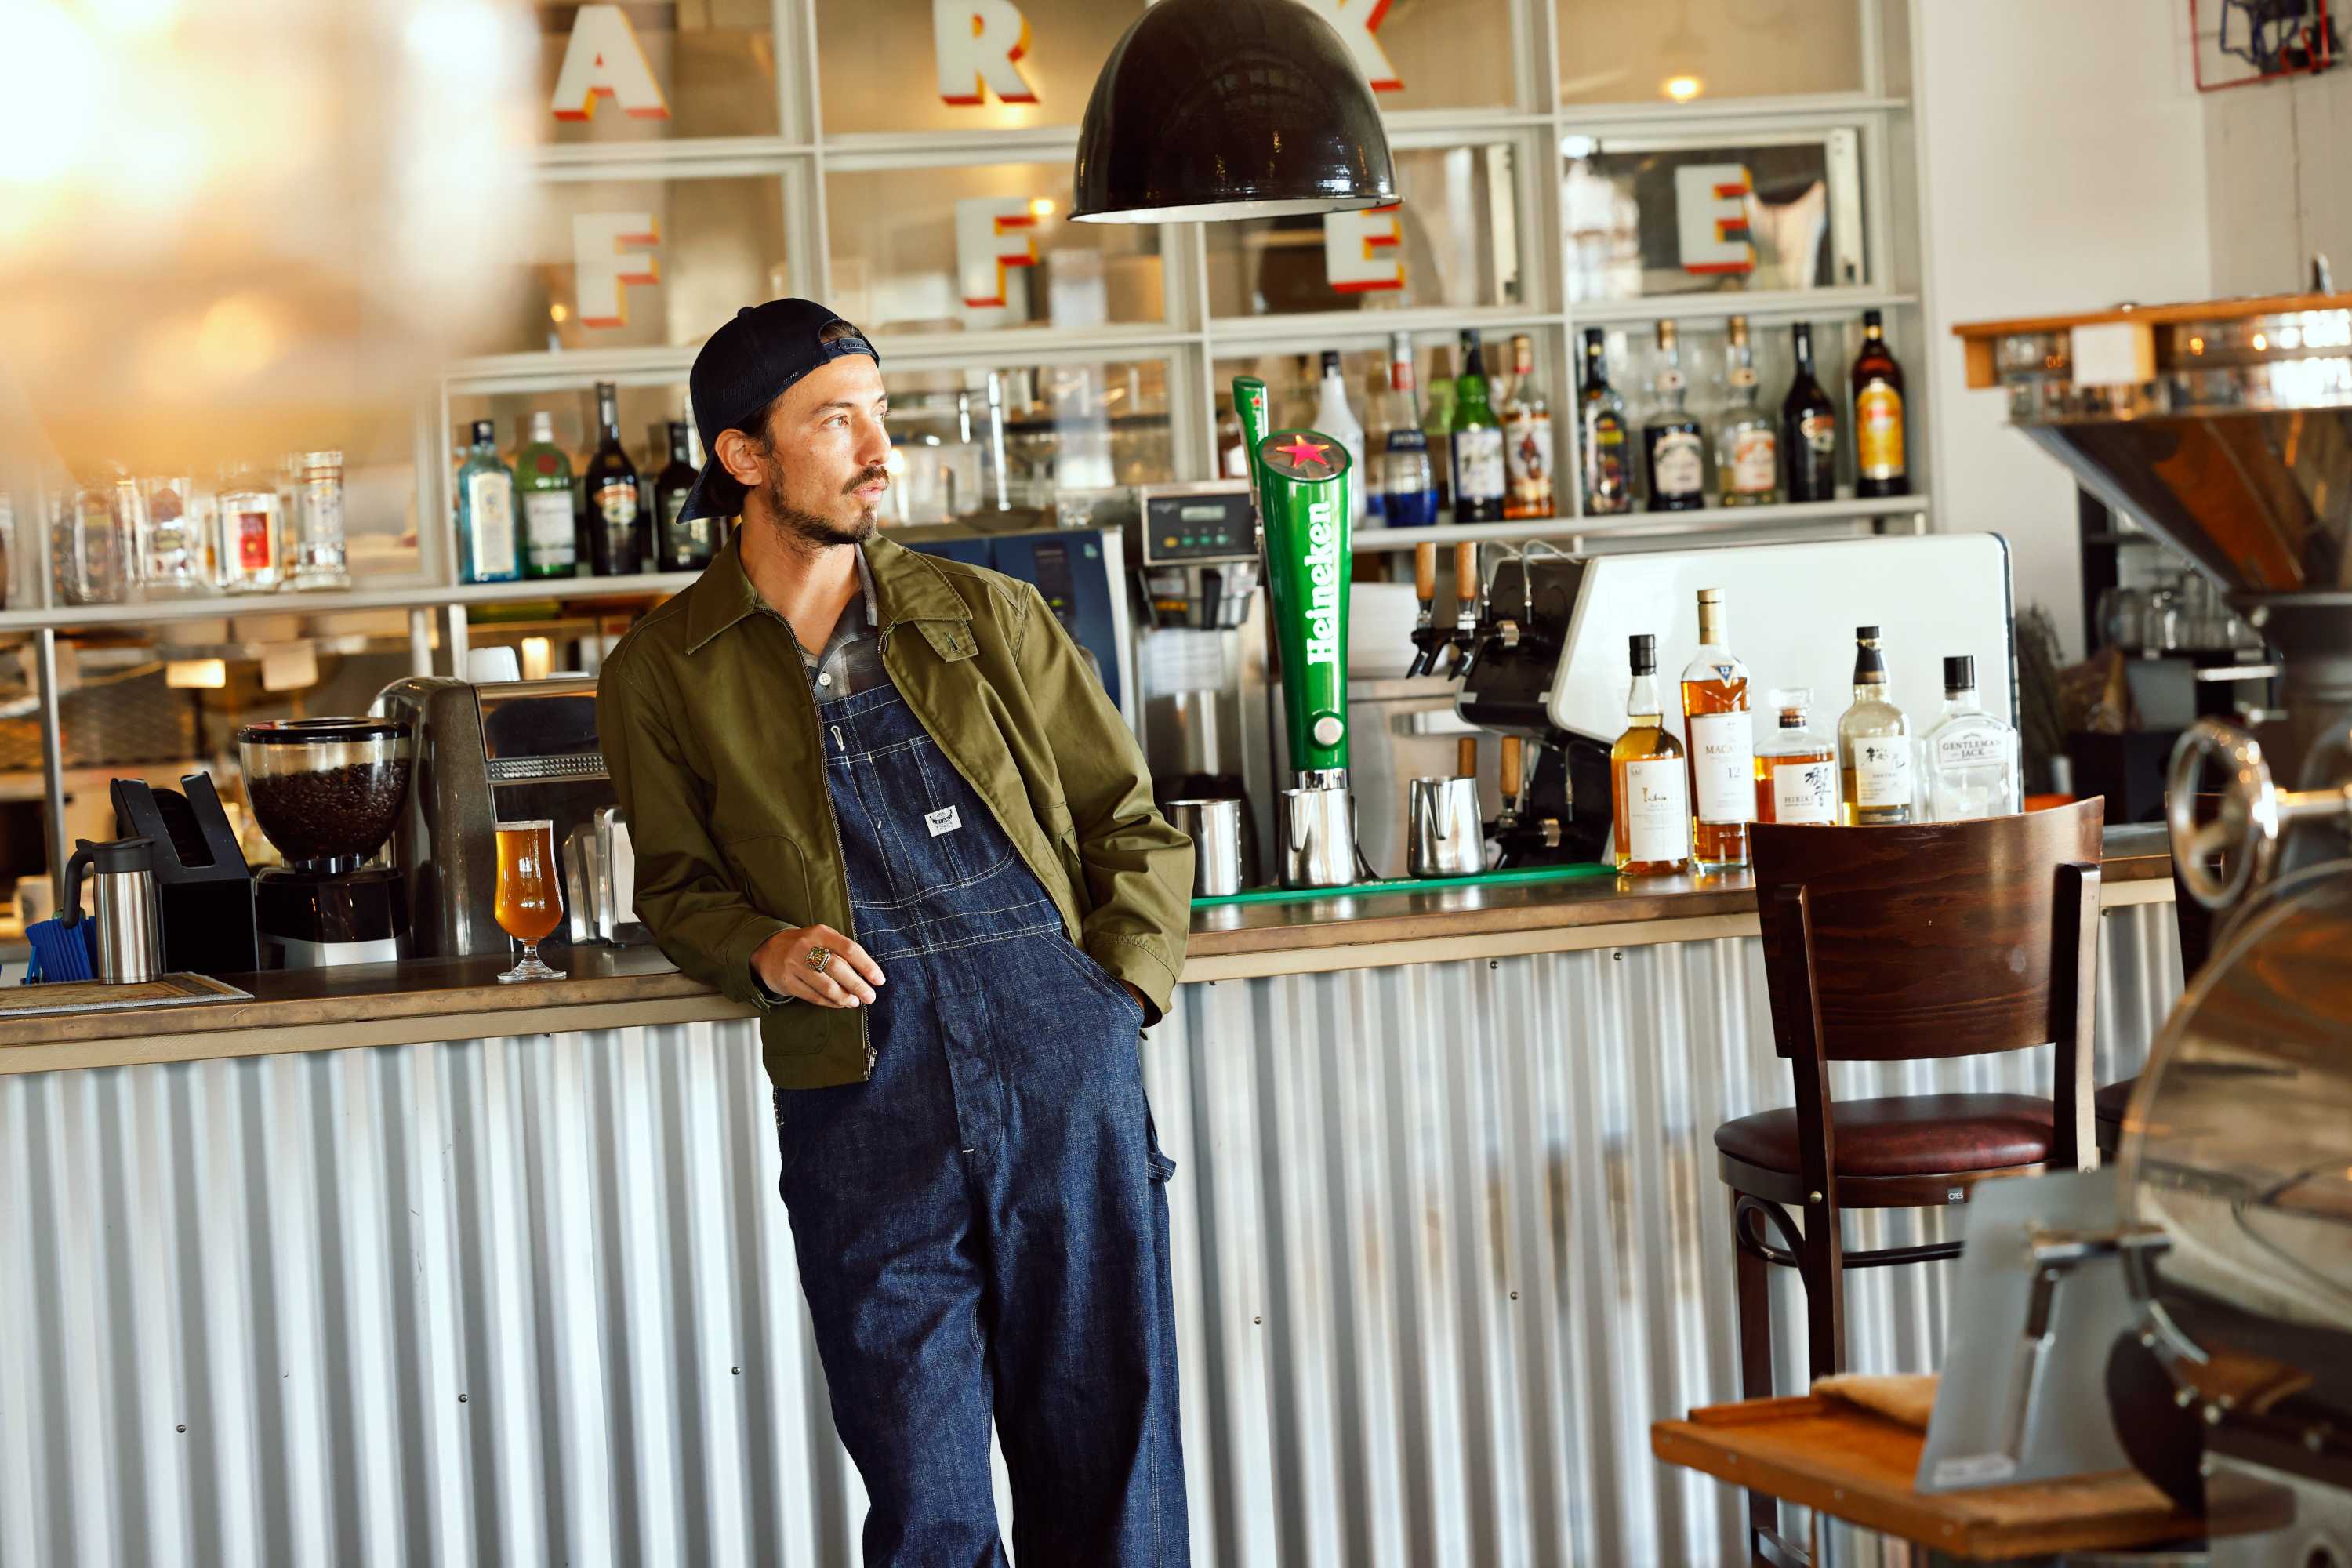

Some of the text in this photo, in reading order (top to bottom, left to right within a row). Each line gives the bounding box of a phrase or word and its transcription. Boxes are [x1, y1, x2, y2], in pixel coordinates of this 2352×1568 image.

[1304, 500, 1336, 665] Heineken
[1961, 748, 1985, 759] JACK
[1727, 767, 1741, 779] 12
